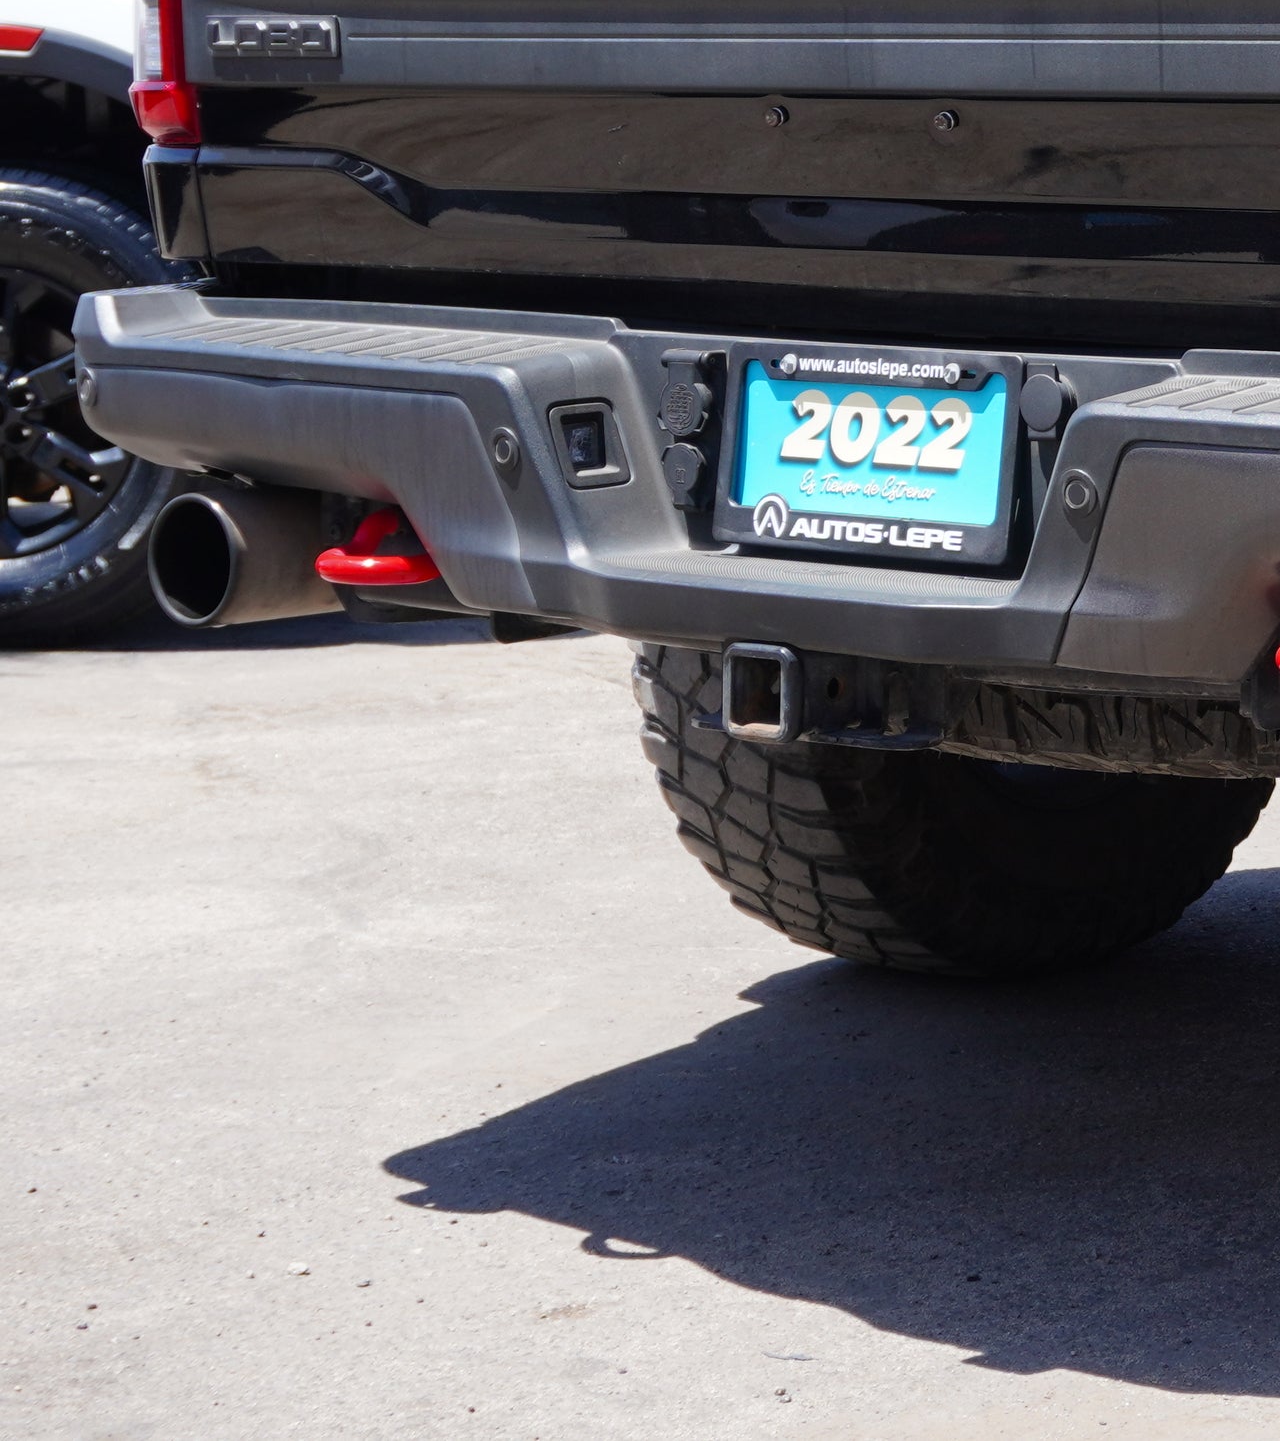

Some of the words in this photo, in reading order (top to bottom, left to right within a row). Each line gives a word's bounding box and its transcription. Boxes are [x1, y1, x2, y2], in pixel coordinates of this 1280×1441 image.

[207, 16, 339, 57] LOBO
[799, 357, 944, 380] www.autoslepe.com
[780, 389, 972, 471] 2022
[863, 479, 879, 496] de
